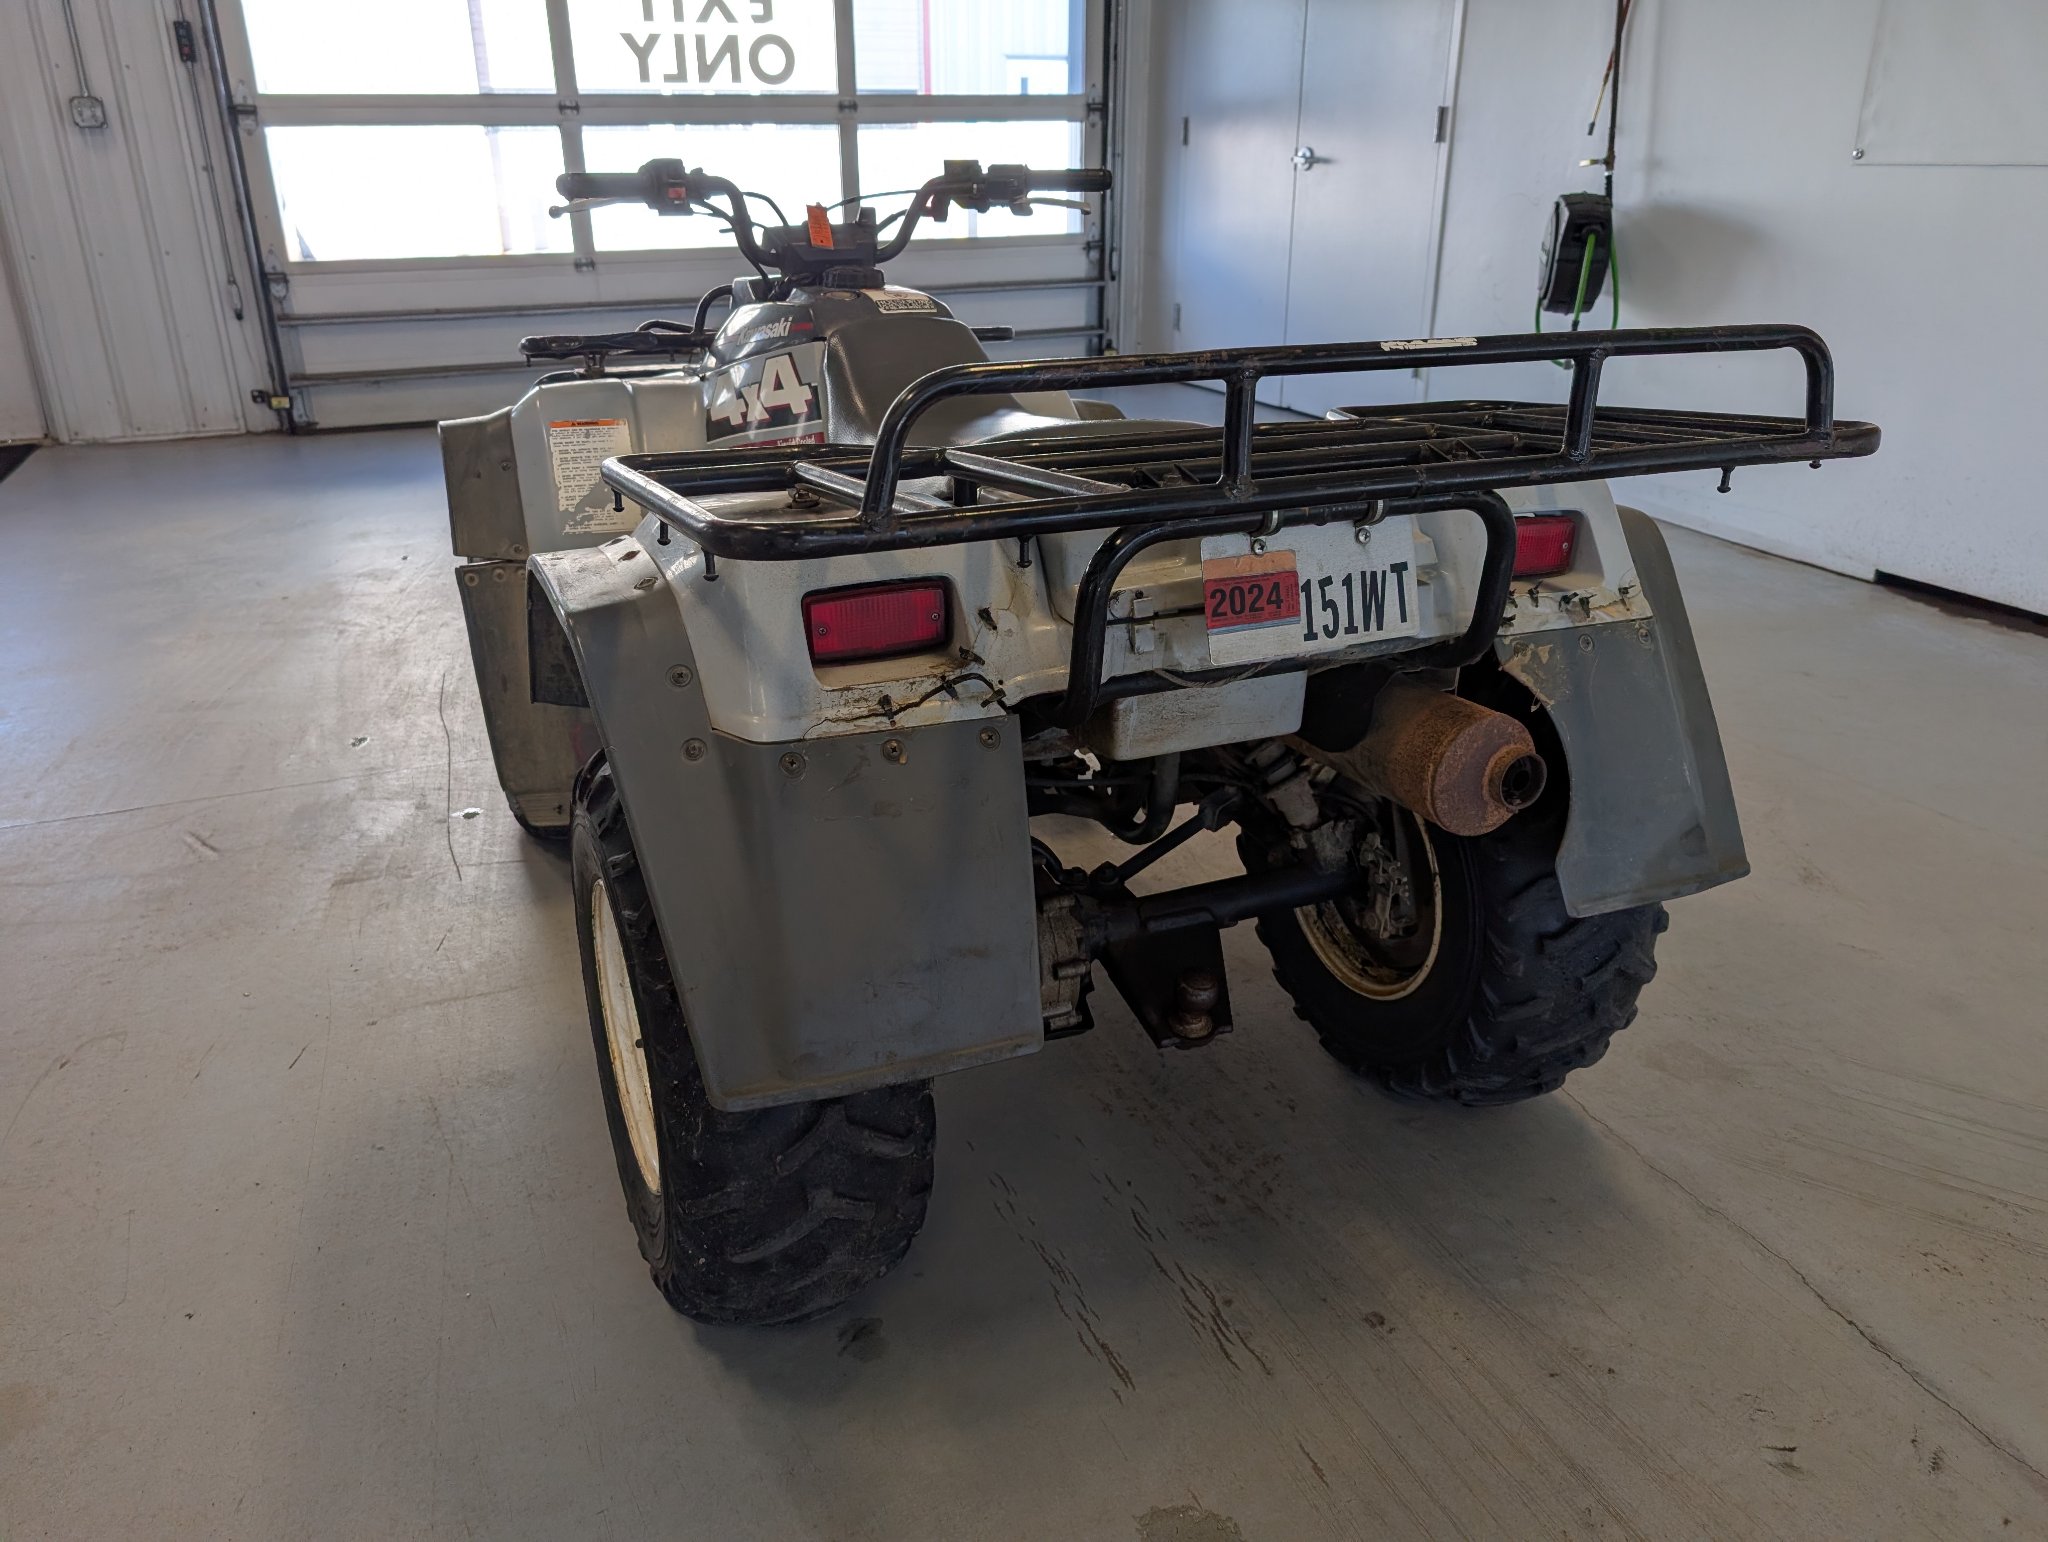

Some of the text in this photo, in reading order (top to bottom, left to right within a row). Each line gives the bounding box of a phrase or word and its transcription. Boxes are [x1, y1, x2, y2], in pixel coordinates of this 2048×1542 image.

[737, 316, 793, 346] Kawasaki
[710, 353, 813, 427] 4x4
[1209, 582, 1284, 618] 2024
[1300, 561, 1409, 642] 151WT
